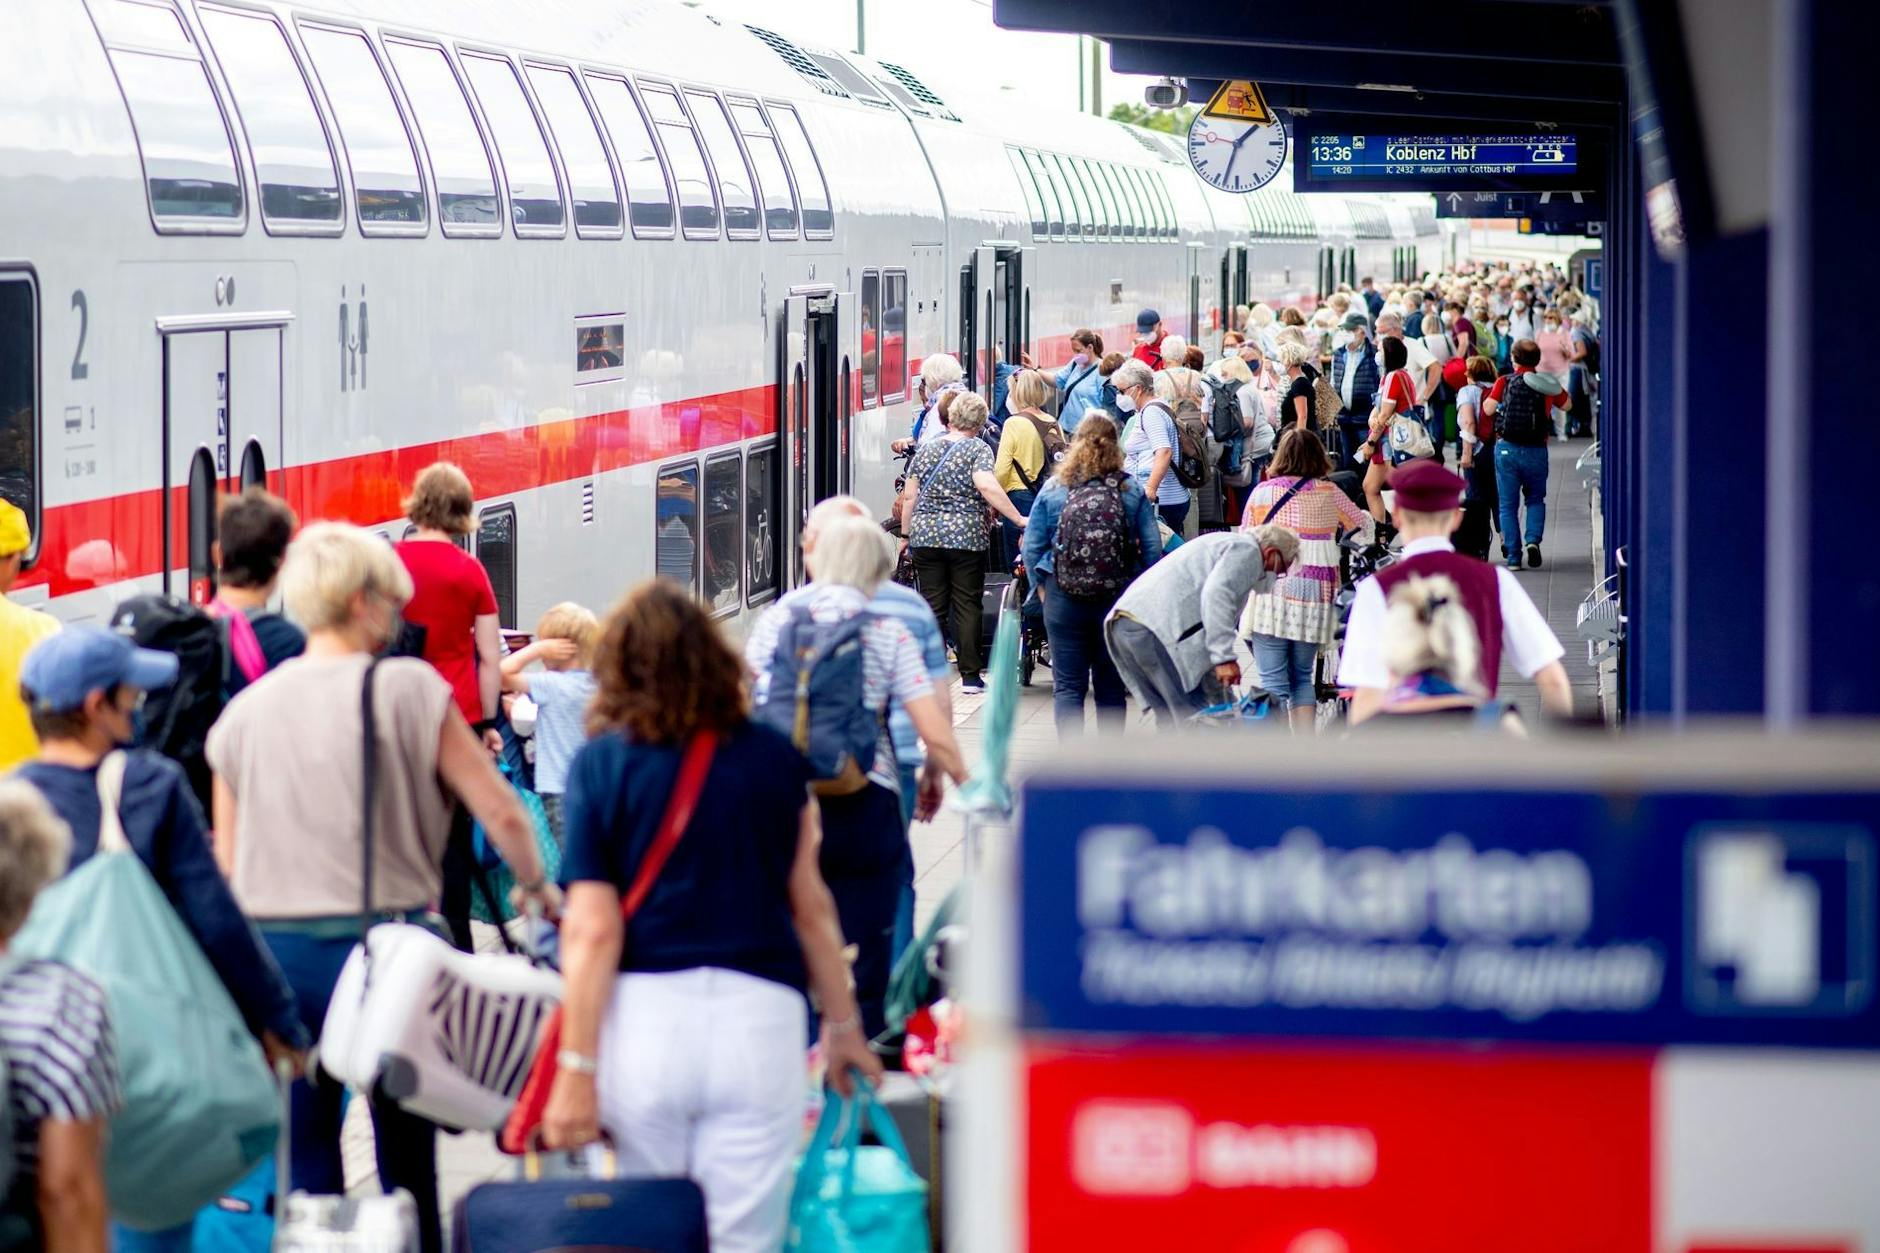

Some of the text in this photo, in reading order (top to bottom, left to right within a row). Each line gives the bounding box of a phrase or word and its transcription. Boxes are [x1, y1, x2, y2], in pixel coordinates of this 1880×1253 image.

[1311, 136, 1319, 144] IC
[1312, 147, 1352, 161] 13:36
[1386, 145, 1476, 160] Koblenz Hbf
[1332, 166, 1352, 174] 14:20
[1386, 166, 1393, 174] IC
[1396, 166, 1414, 174] 2432
[1420, 166, 1451, 174] Ankunft
[1470, 165, 1501, 174] Cottbus
[1503, 165, 1516, 173] Hbf
[71, 289, 89, 381] 2
[1082, 832, 1588, 934] Fahrkarten
